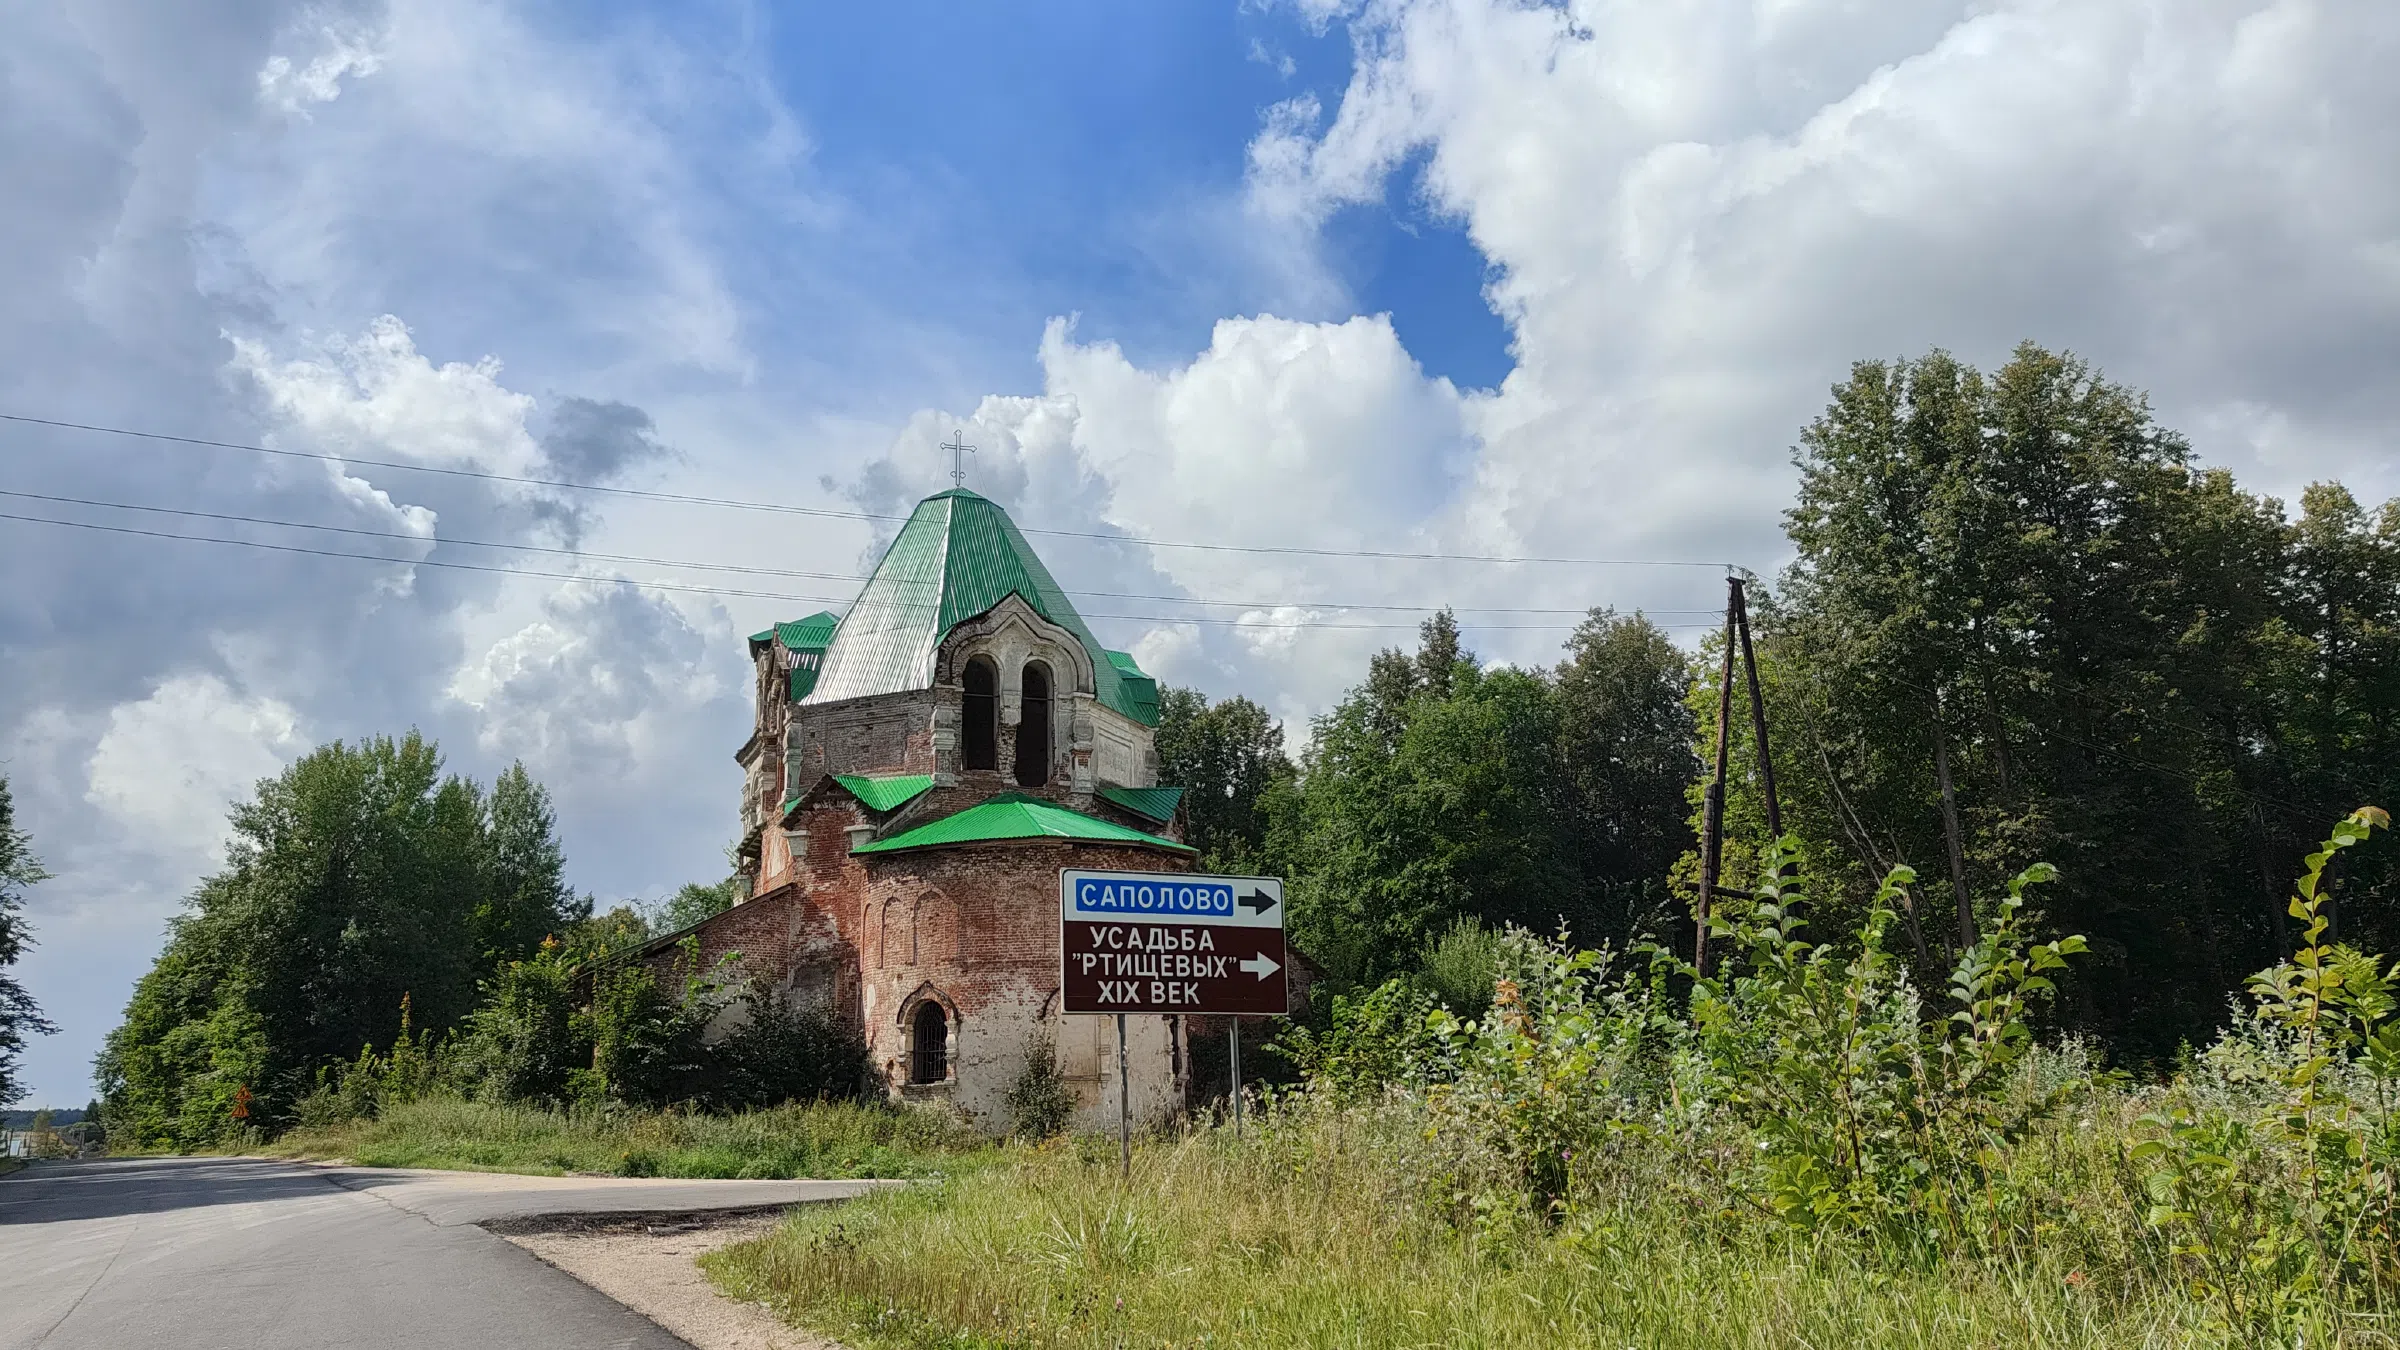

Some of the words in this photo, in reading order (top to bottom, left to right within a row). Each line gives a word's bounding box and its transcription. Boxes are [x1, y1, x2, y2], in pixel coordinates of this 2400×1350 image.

[1081, 884, 1229, 911] САПОЛОВО
[1089, 926, 1215, 954] УСАДЬБА
[1097, 980, 1141, 1003] XIX
[1150, 982, 1200, 1005] ВЕК
